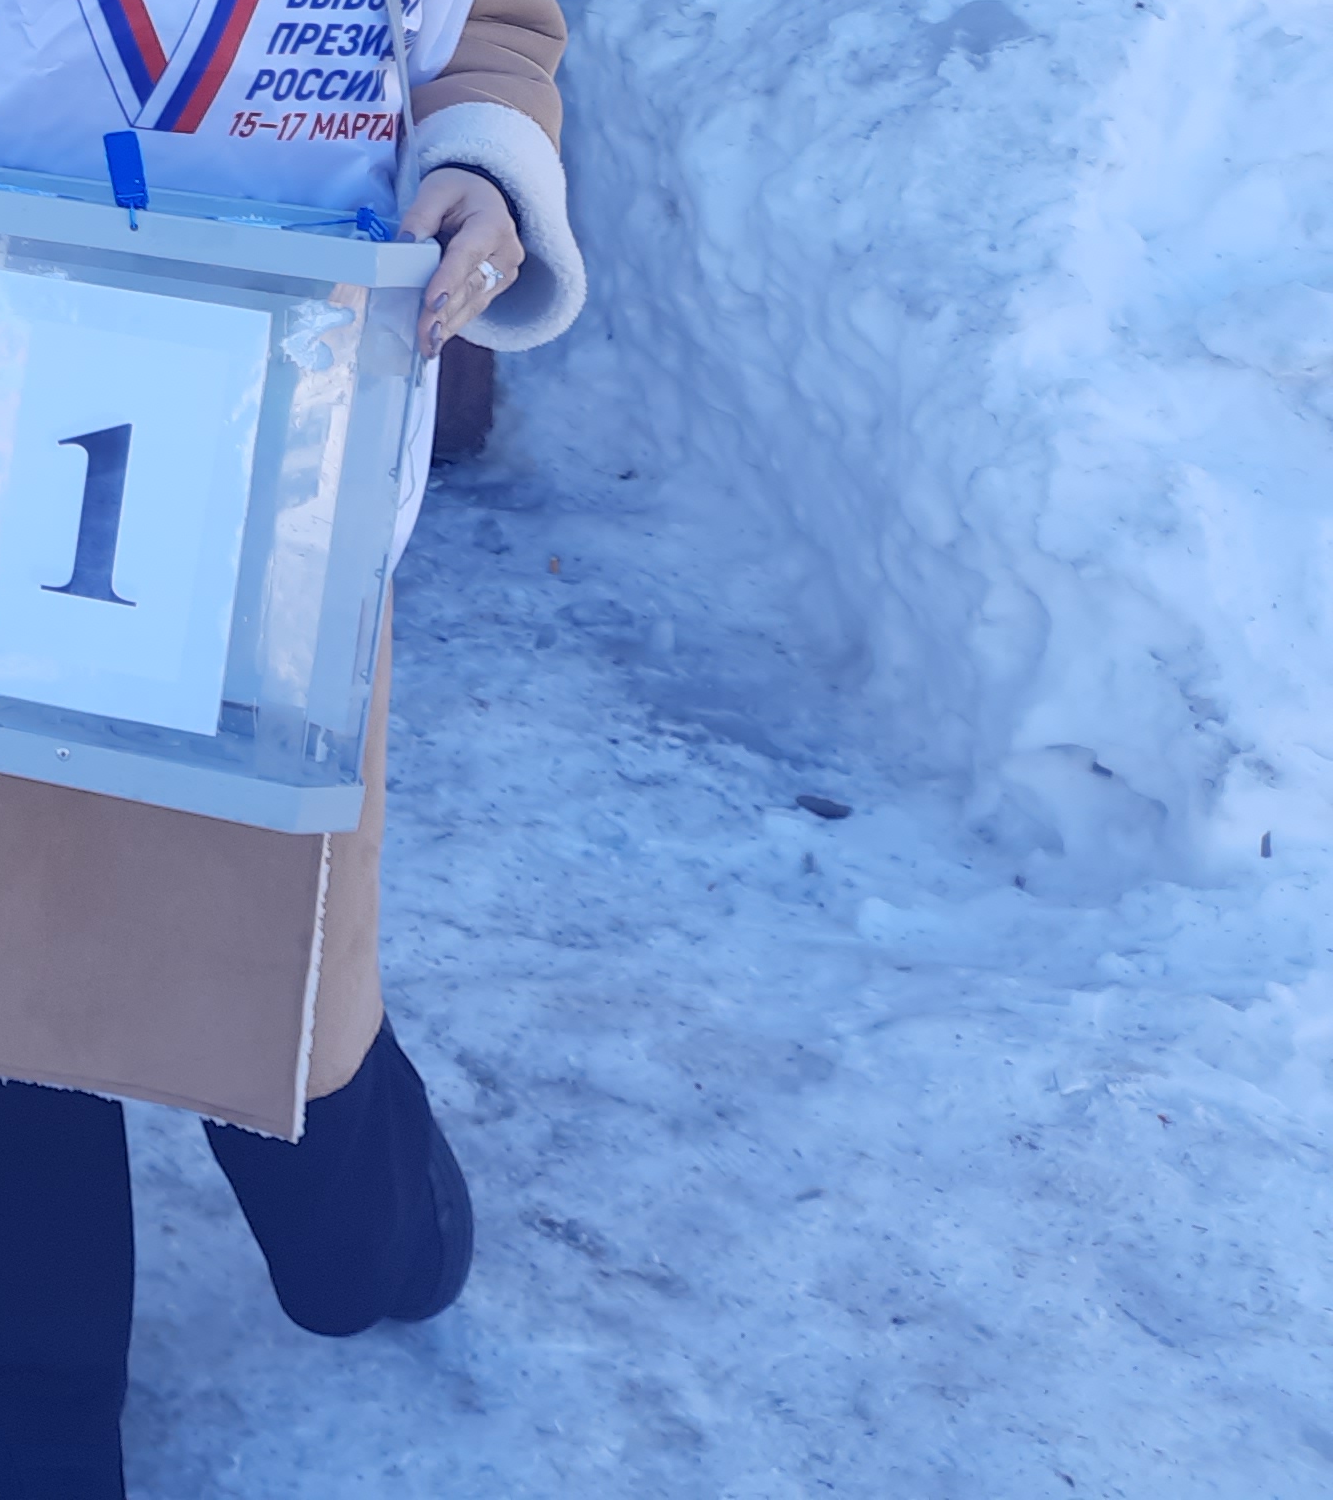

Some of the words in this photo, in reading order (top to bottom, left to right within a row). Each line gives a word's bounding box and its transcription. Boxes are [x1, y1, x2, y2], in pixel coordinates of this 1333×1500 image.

[244, 67, 389, 103] РОССИИ
[307, 112, 394, 142] МАРТА
[39, 422, 137, 608] 1
